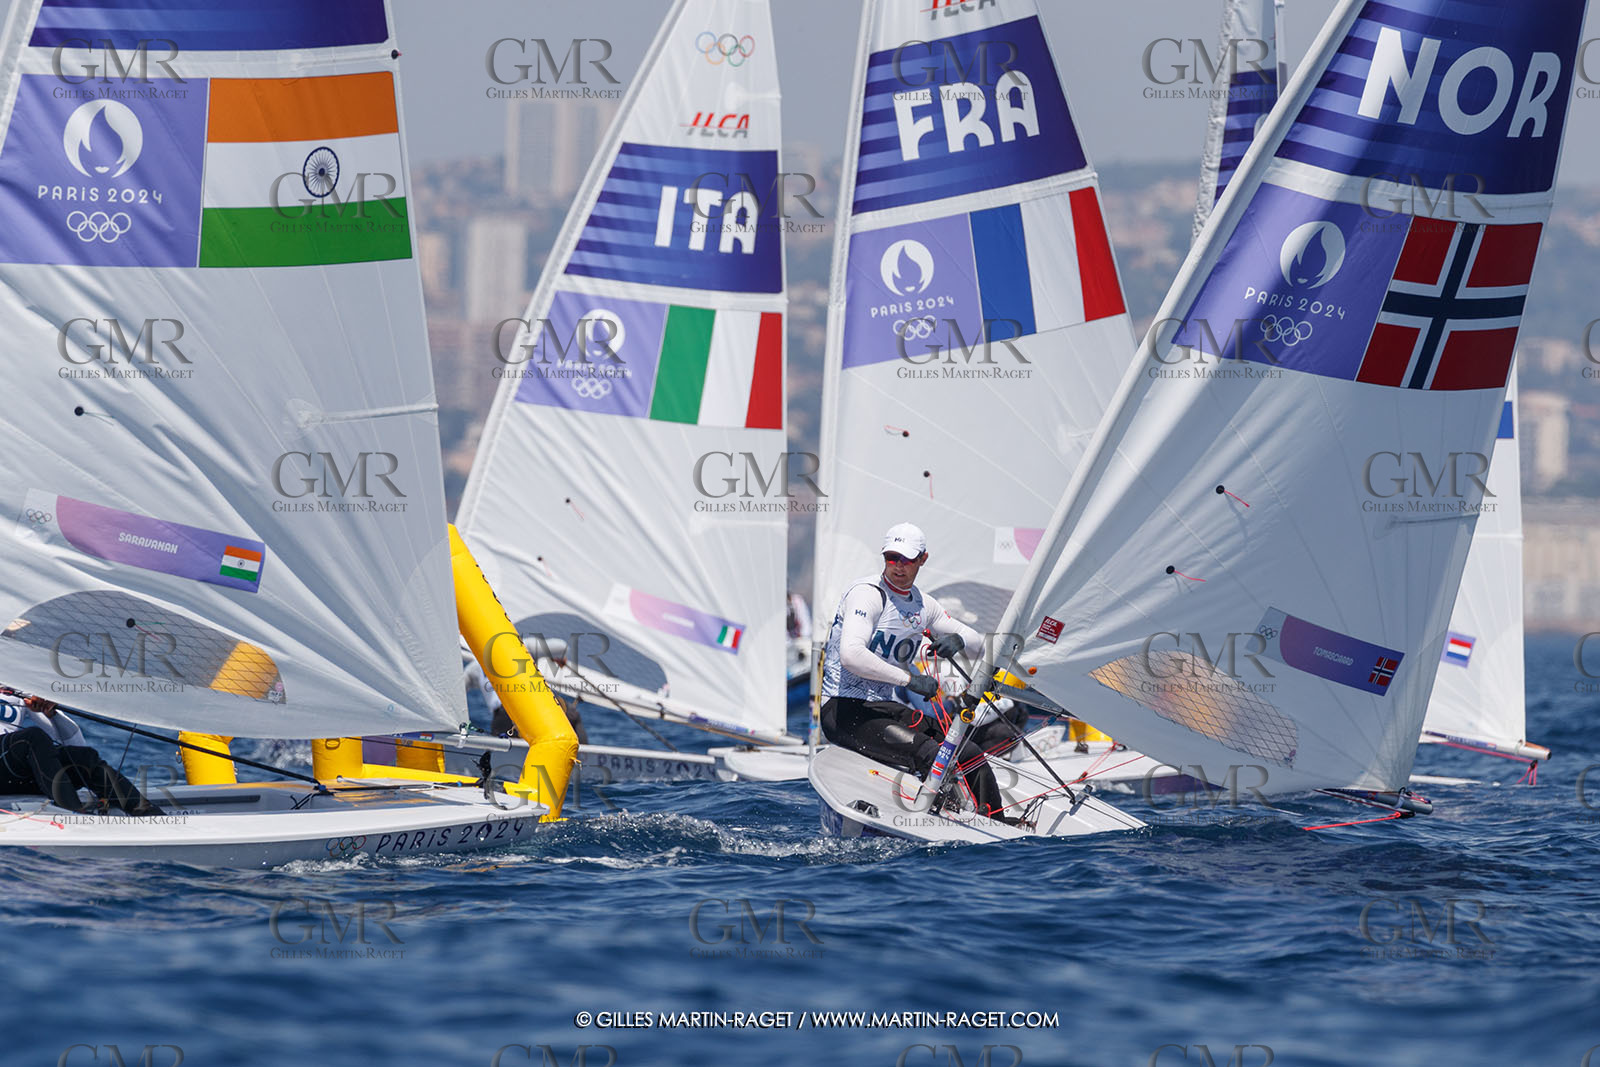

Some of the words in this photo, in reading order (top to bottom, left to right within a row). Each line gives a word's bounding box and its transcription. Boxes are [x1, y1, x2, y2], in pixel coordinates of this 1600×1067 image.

[1357, 26, 1561, 138] NOR
[686, 111, 750, 138] ILCA
[894, 70, 1040, 161] FRA
[38, 185, 99, 201] PARIS
[107, 188, 162, 204] 2024
[654, 185, 759, 254] ITA
[870, 301, 912, 318] PARIS
[916, 296, 954, 311] 2024
[1244, 287, 1293, 308] PARIS
[1298, 298, 1345, 320] 2024
[118, 532, 178, 554] SARAVANAN
[598, 754, 656, 773] PARIS
[663, 759, 716, 778] 2024
[376, 828, 451, 852] PARIS
[458, 819, 524, 845] 2024
